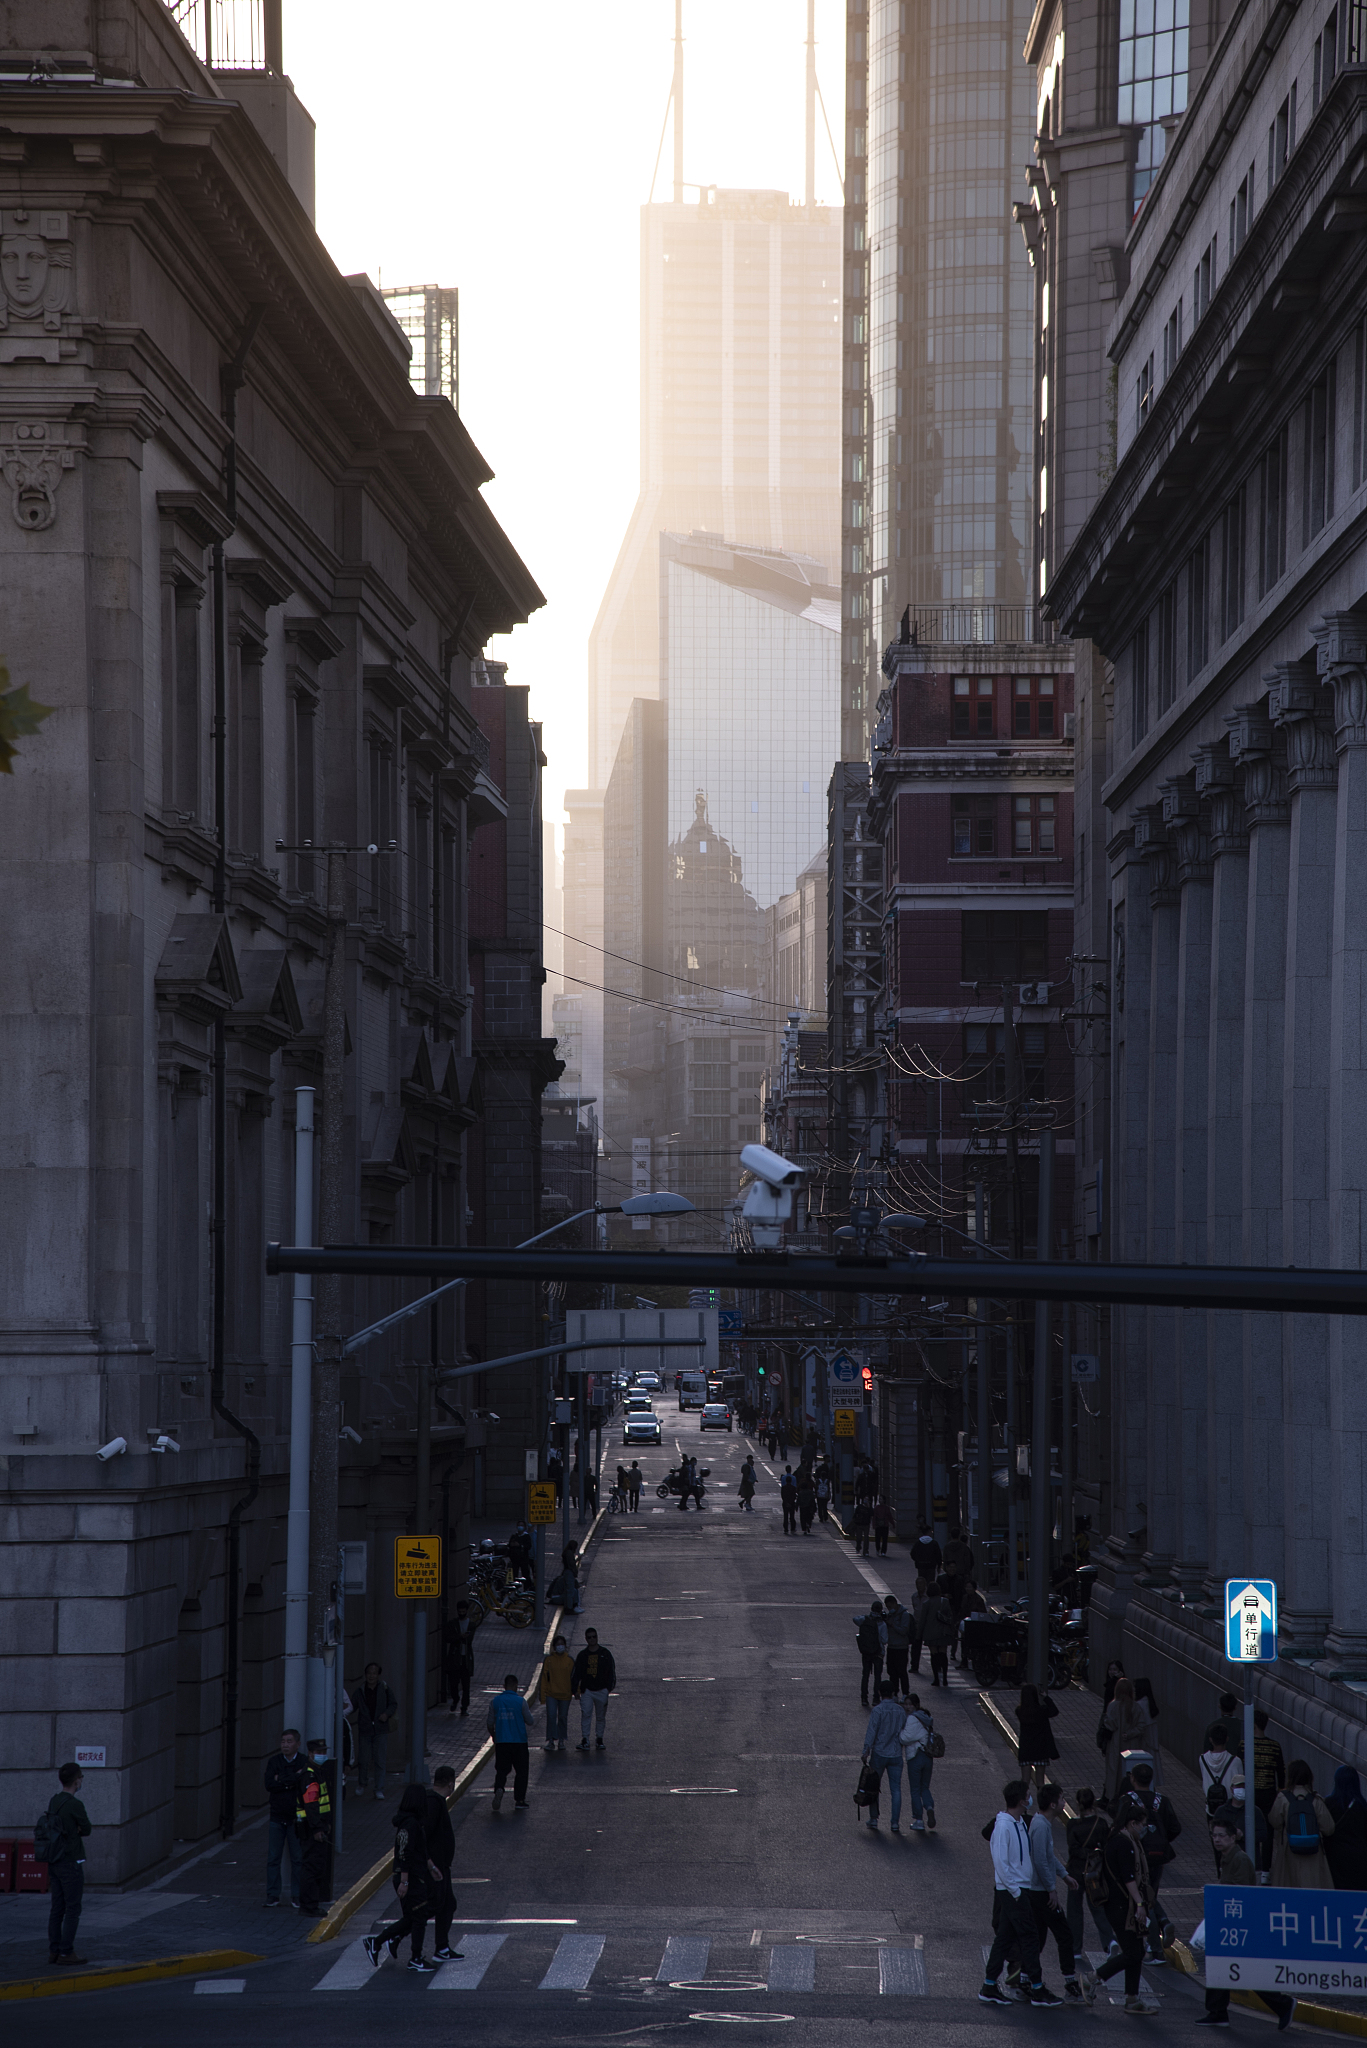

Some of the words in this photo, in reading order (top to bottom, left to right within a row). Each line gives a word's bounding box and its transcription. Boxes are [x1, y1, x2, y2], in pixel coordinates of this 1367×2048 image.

[1245, 1612, 1258, 1656] 单行道
[1223, 1897, 1243, 1919] 南
[1219, 1927, 1249, 1947] 287
[1228, 1962, 1241, 1982] S
